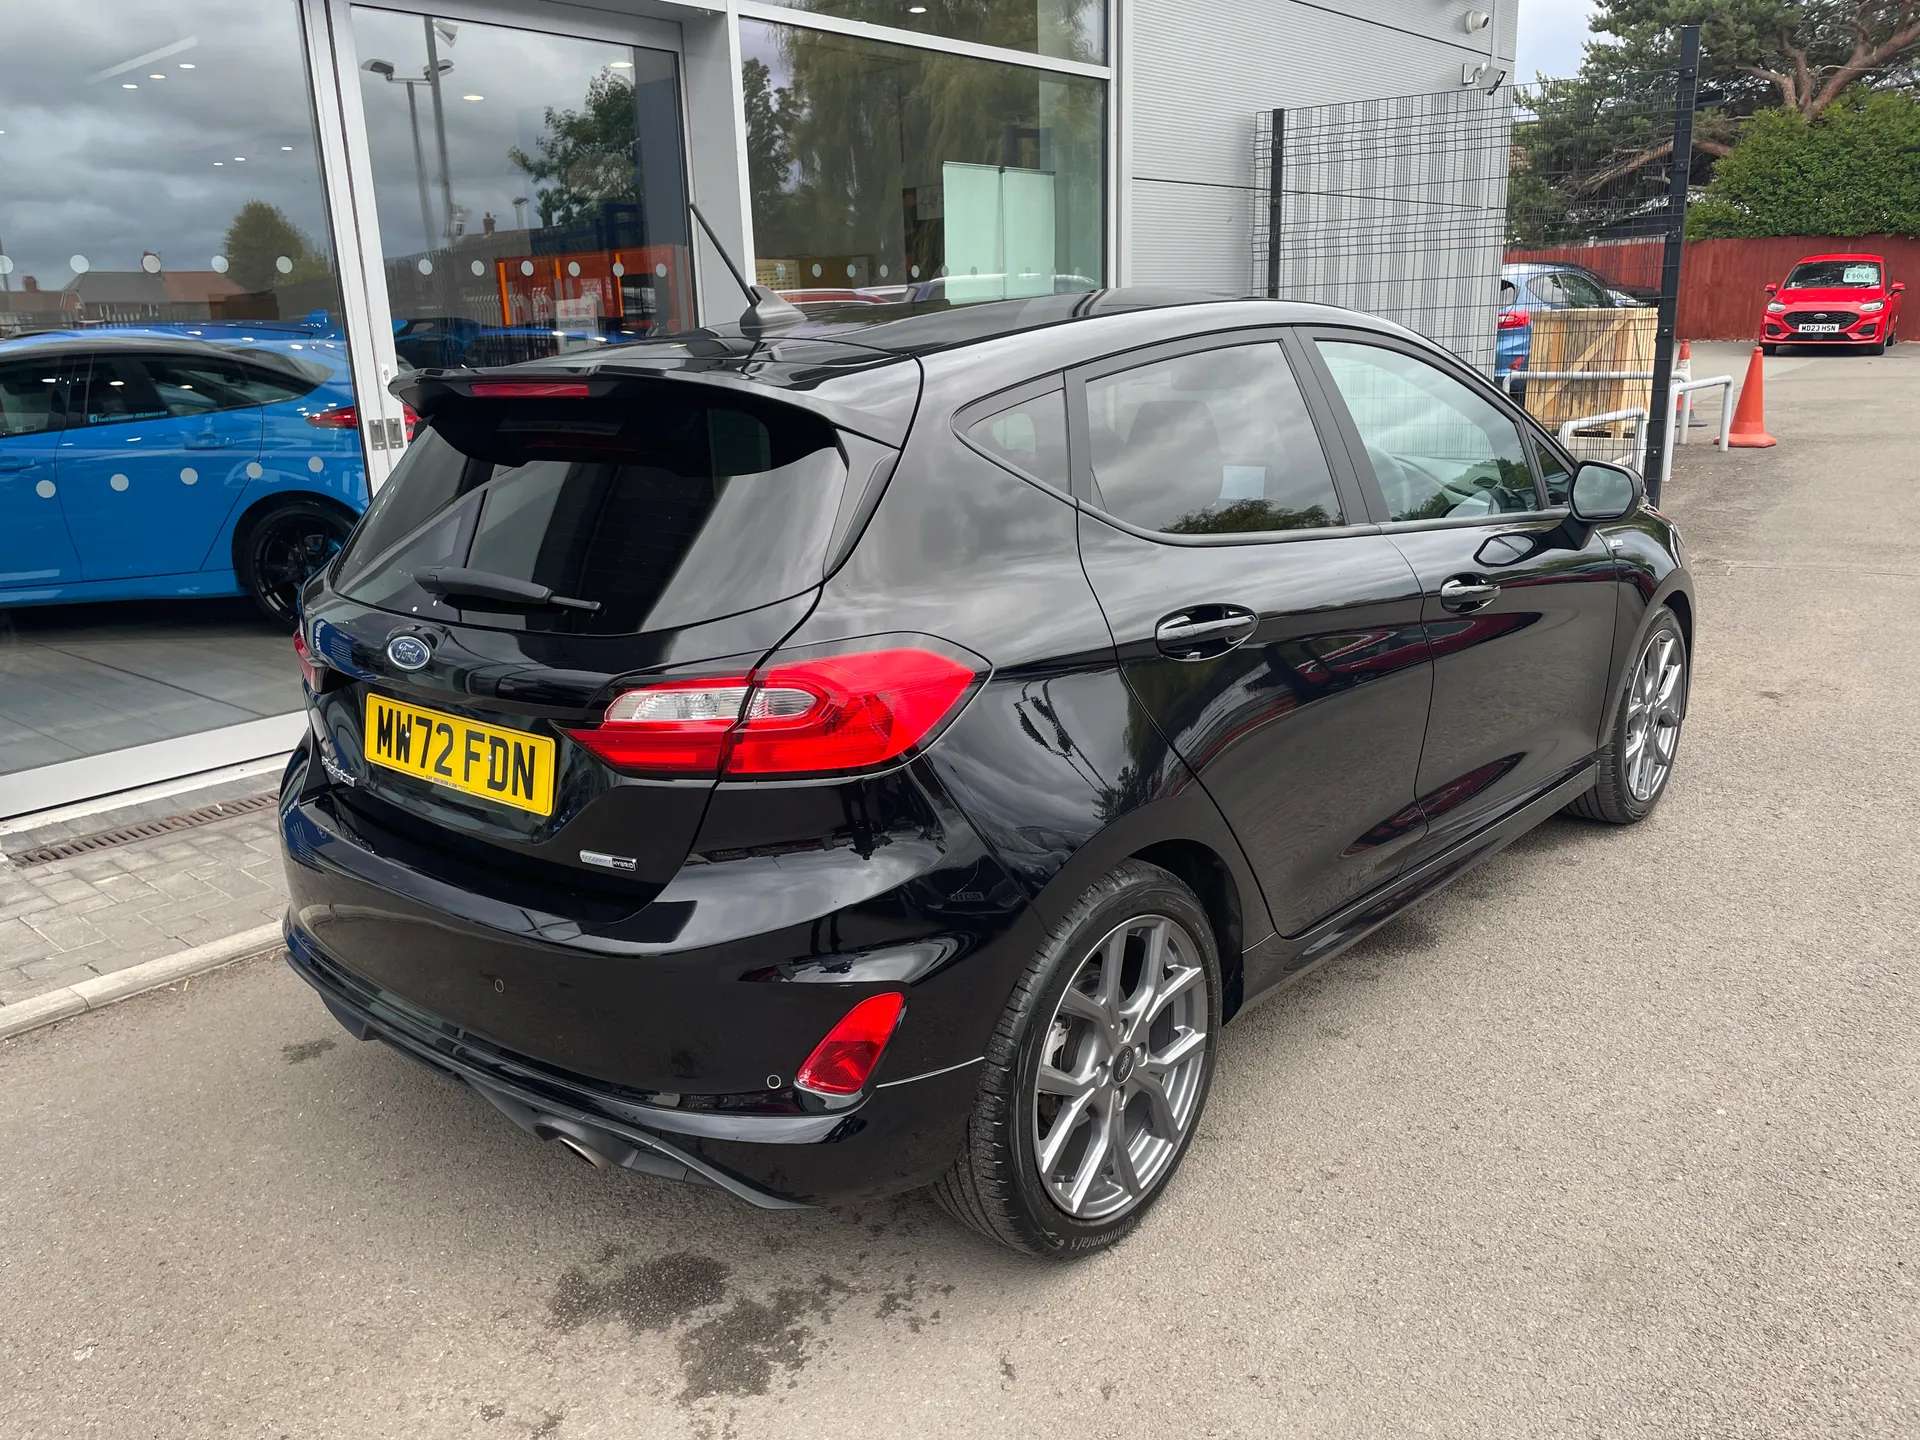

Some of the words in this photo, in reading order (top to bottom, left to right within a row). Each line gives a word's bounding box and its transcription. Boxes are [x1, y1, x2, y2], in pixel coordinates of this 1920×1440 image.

[396, 642, 419, 663] Ford
[376, 705, 454, 777] MW72
[464, 729, 535, 800] FDN
